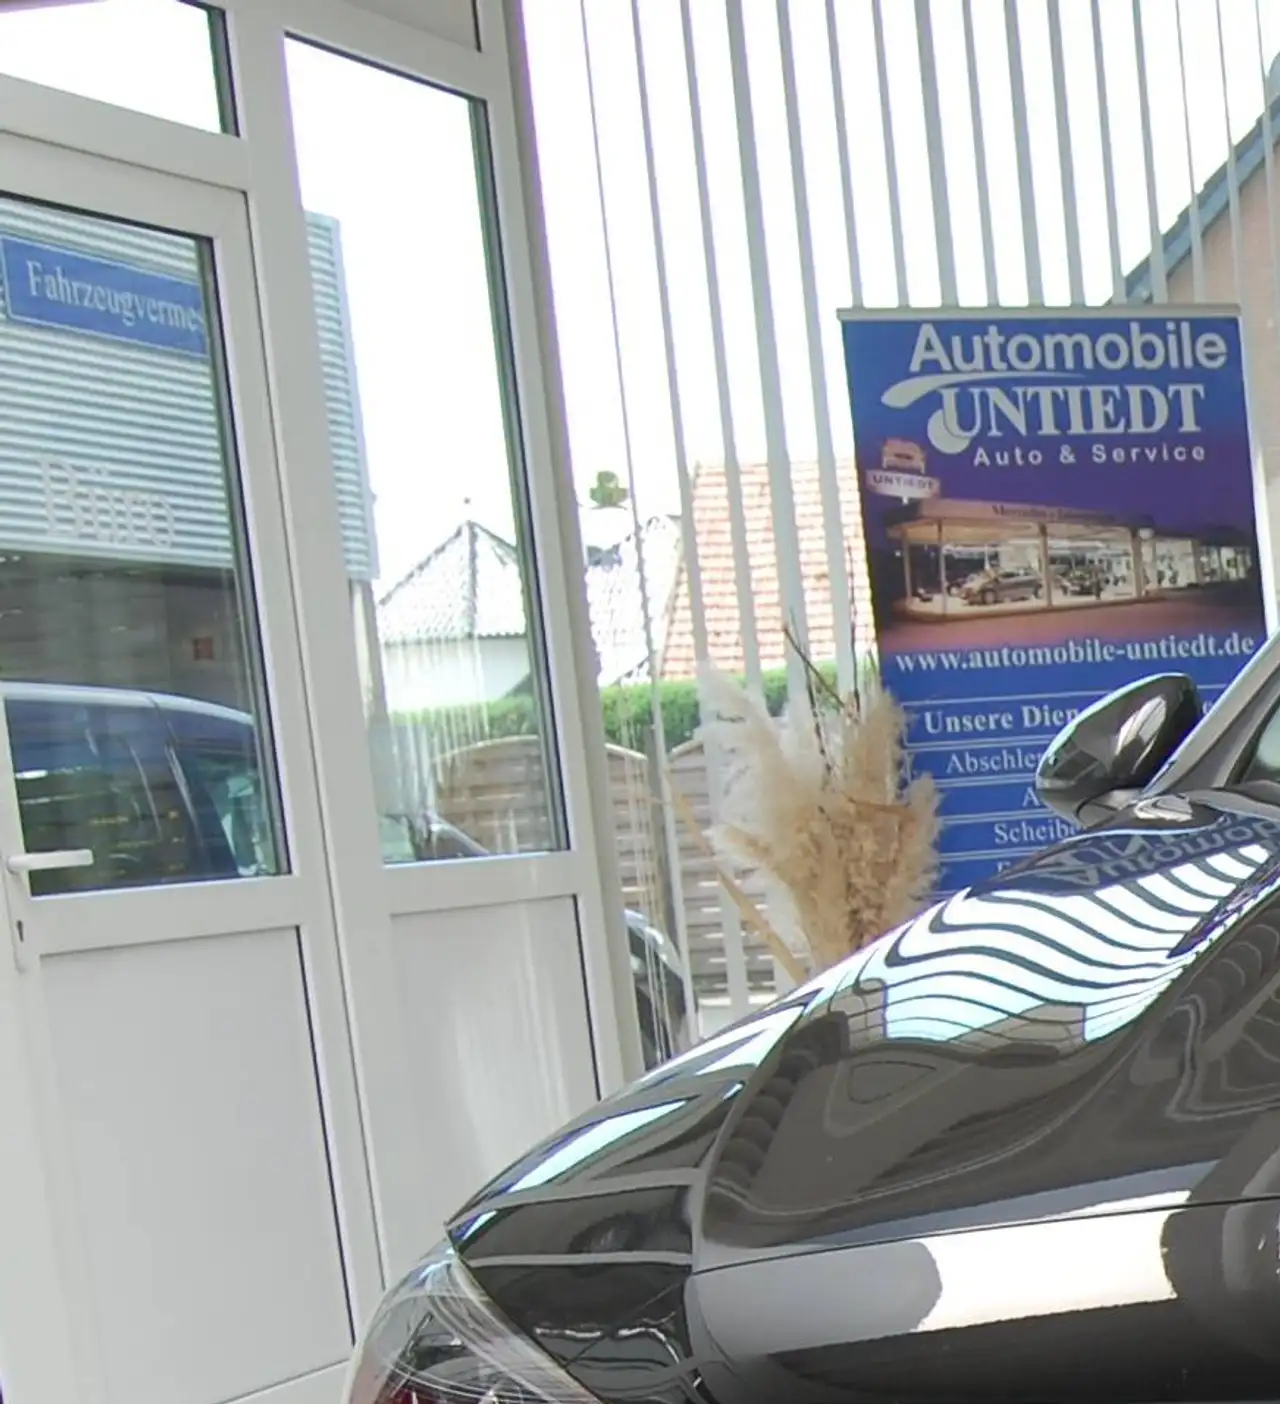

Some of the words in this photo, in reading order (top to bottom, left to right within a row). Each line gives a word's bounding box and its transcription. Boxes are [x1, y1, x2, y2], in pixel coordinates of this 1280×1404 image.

[909, 321, 1227, 373] Automobile
[938, 383, 1206, 440] UNTIEDT
[973, 446, 1043, 467] Auto
[1058, 444, 1077, 464] &
[1092, 443, 1206, 464] Service
[38, 457, 175, 548] Büro
[896, 633, 1255, 672] www.automobile-untiedt.de
[924, 707, 1015, 736] Unsere
[946, 748, 1041, 774] Abschle
